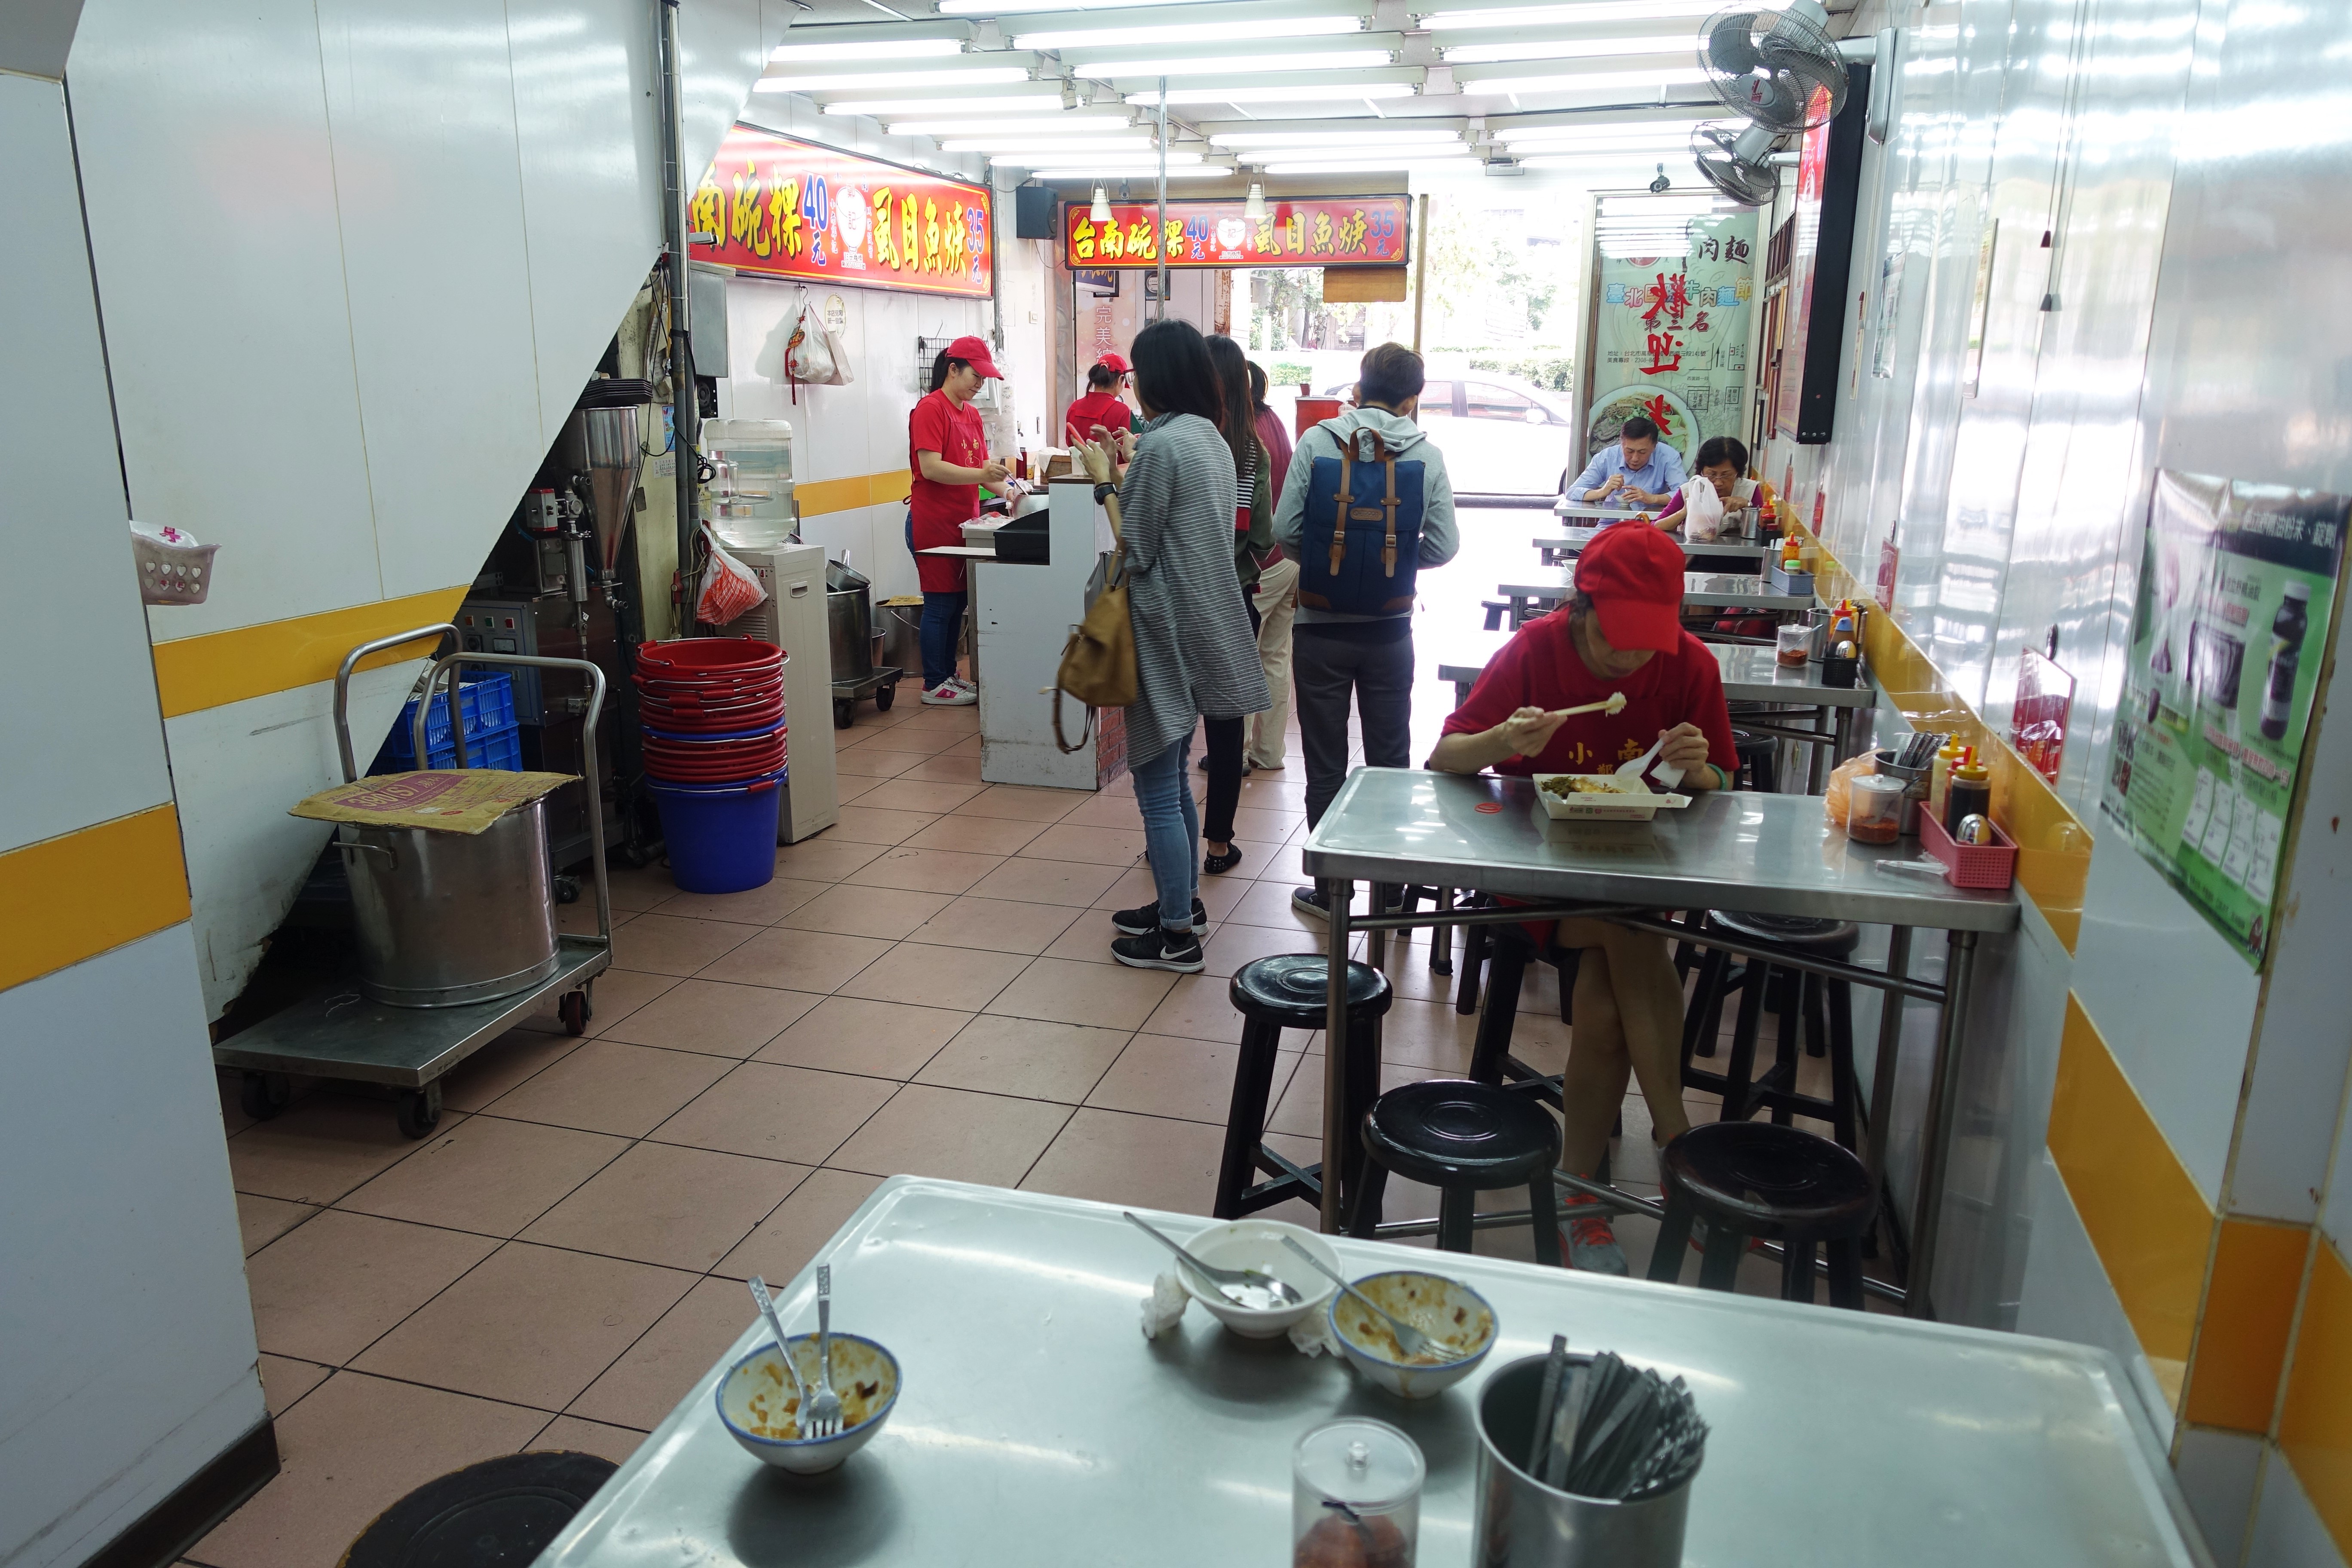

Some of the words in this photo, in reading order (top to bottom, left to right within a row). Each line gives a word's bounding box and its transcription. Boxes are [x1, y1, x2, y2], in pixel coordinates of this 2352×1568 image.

[803, 173, 828, 232] 40
[966, 206, 985, 255] 35
[1072, 214, 1185, 259] 台南碗粿
[1185, 214, 1209, 242] 40
[1370, 211, 1395, 238] 35
[812, 230, 826, 266] 元
[1190, 241, 1205, 260] 元
[1376, 239, 1390, 256] 元
[971, 254, 983, 285] 元
